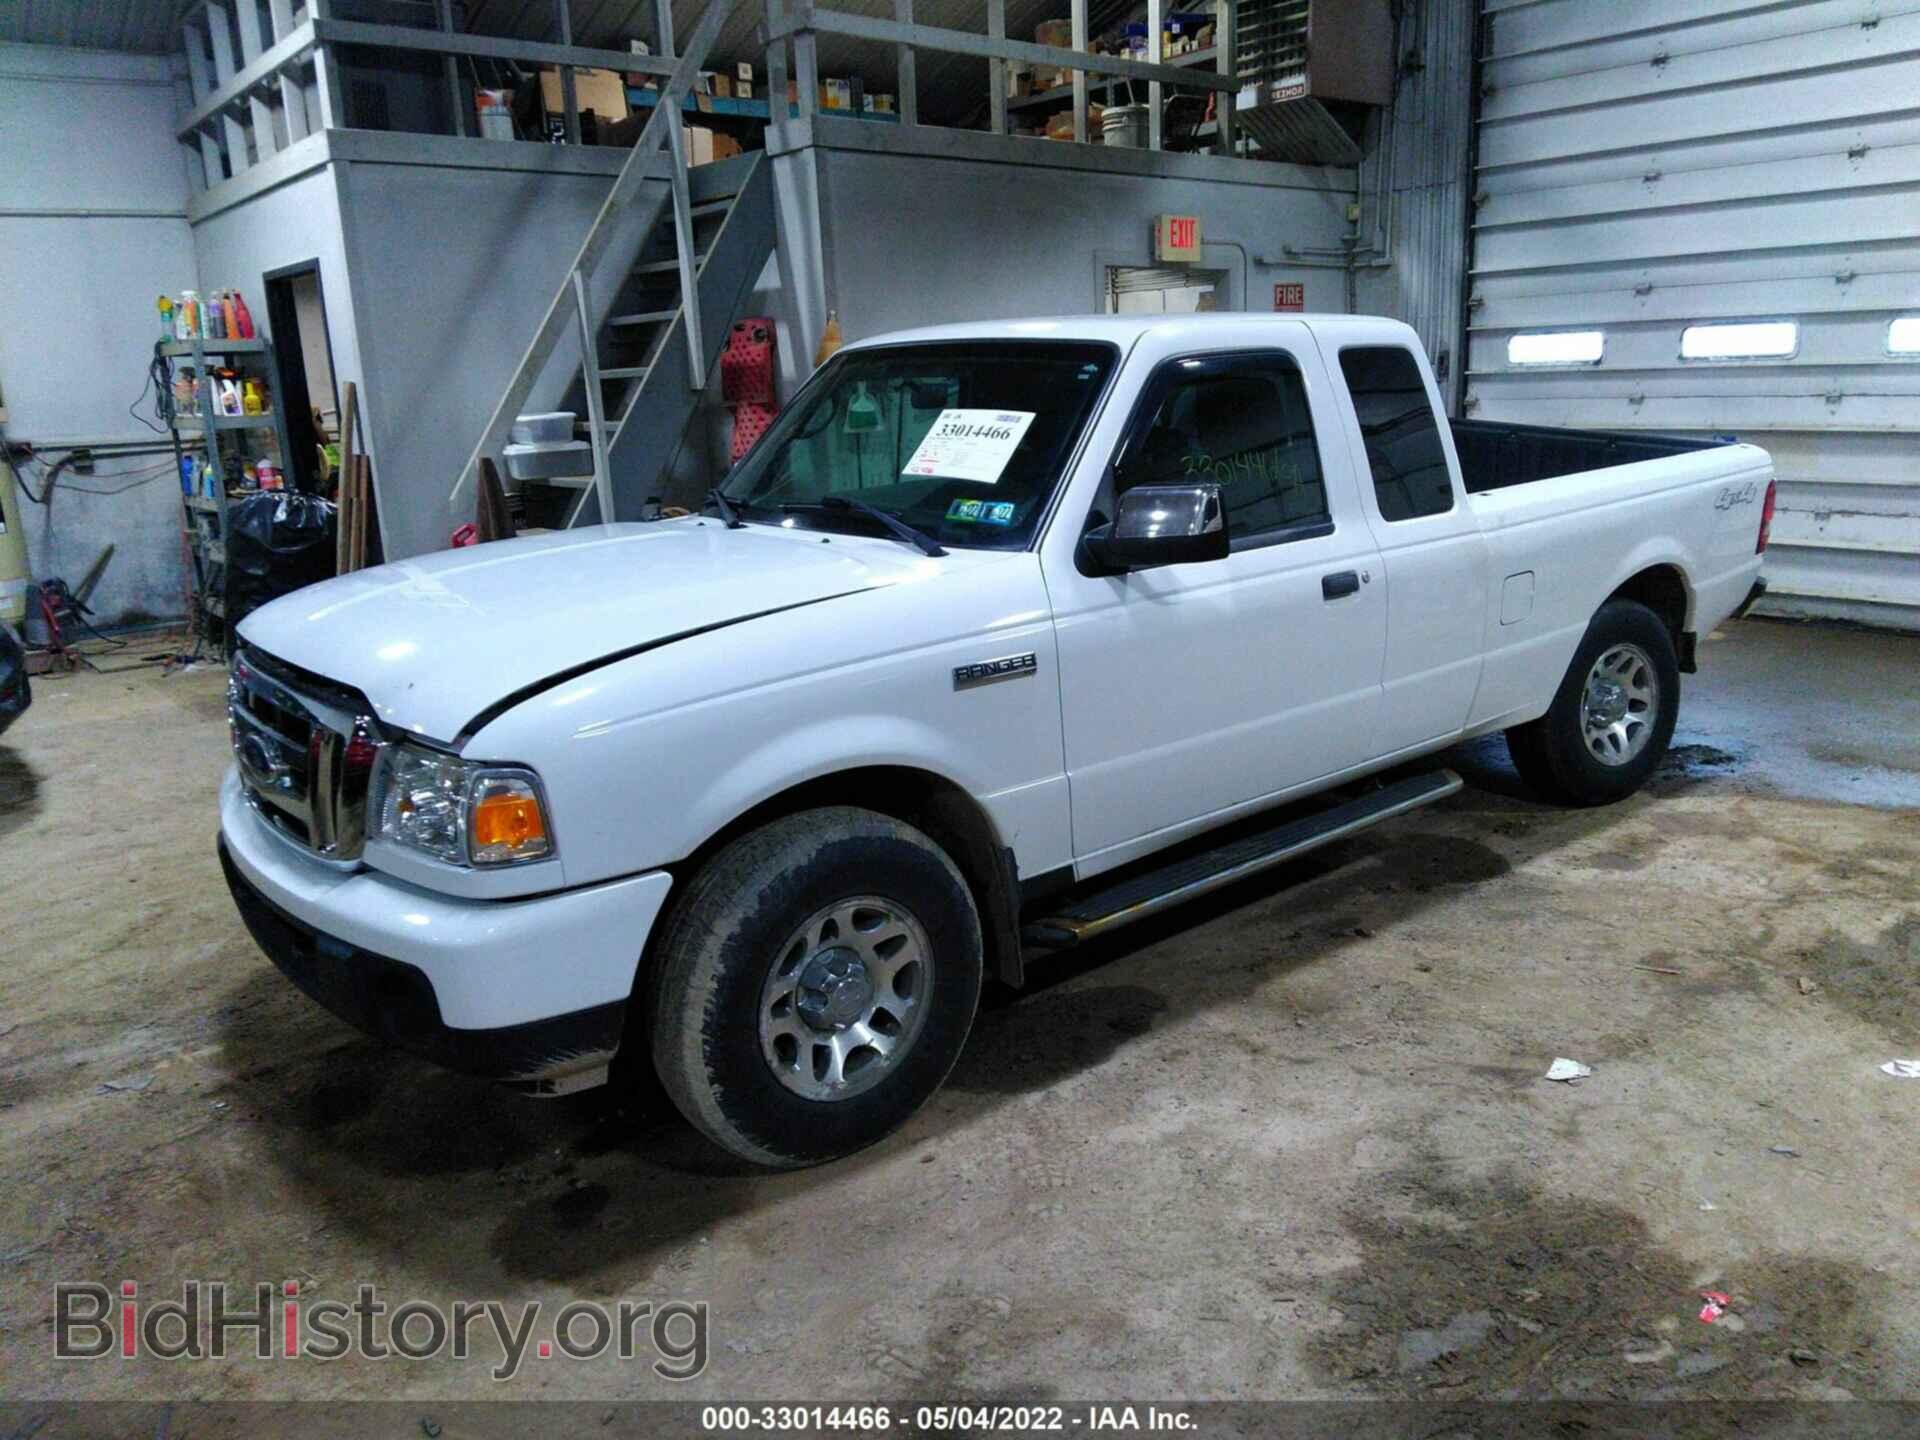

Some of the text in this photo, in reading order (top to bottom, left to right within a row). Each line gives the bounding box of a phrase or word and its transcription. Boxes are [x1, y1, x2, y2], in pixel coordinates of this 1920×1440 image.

[1169, 217, 1196, 248] EXIT
[1275, 286, 1302, 305] FIRE
[936, 424, 1014, 441] 33014466
